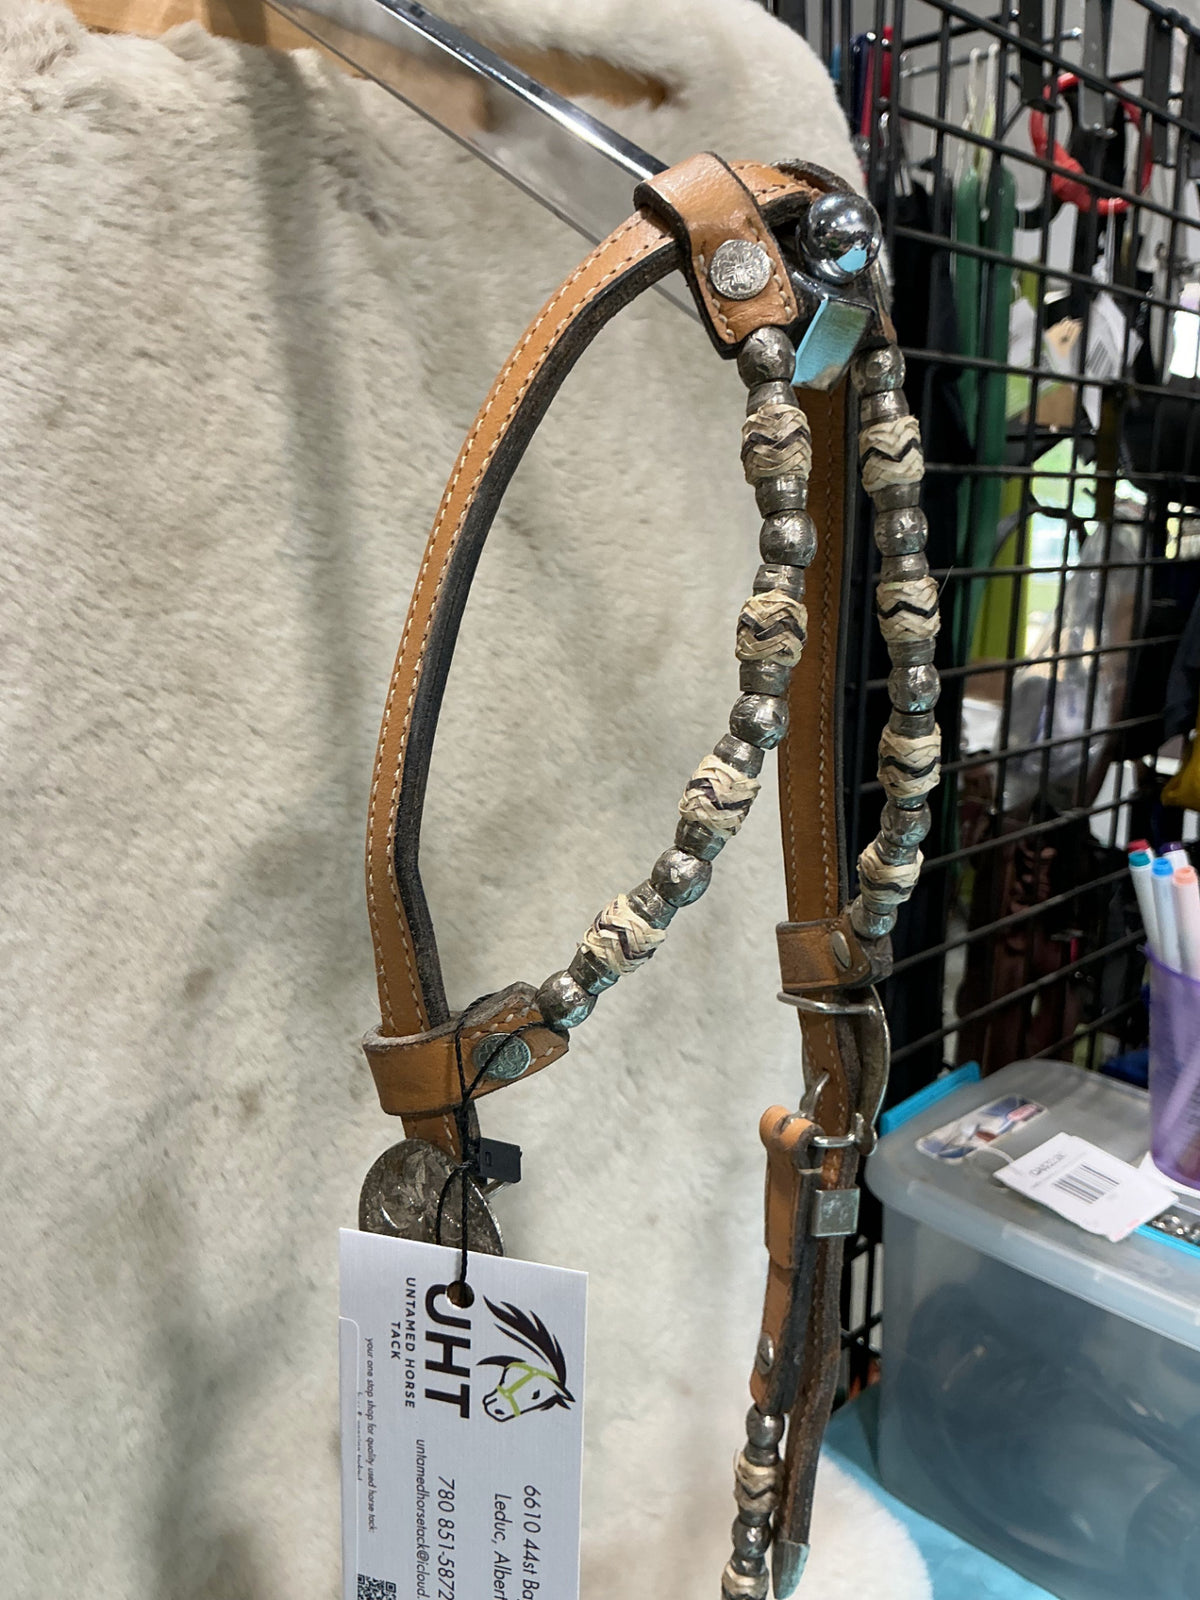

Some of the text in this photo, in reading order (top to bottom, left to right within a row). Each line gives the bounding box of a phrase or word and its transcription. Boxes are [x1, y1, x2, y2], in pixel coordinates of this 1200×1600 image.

[365, 1338, 374, 1358] your
[390, 1321, 402, 1360] TACK
[404, 1277, 417, 1409] UNTAMED HORSE
[424, 1284, 472, 1419] UHT
[366, 1360, 374, 1377] one
[365, 1379, 375, 1398] stop
[365, 1400, 377, 1421] shop
[367, 1423, 377, 1435] for
[365, 1437, 377, 1466] quality
[367, 1468, 377, 1488] used
[367, 1489, 377, 1512] horse
[415, 1439, 431, 1600] untamedhorsetack@icloud.
[491, 1493, 512, 1545] Leduc,
[437, 1475, 456, 1600] 780 851-5872
[517, 1484, 542, 1600] 6610 44st Ba
